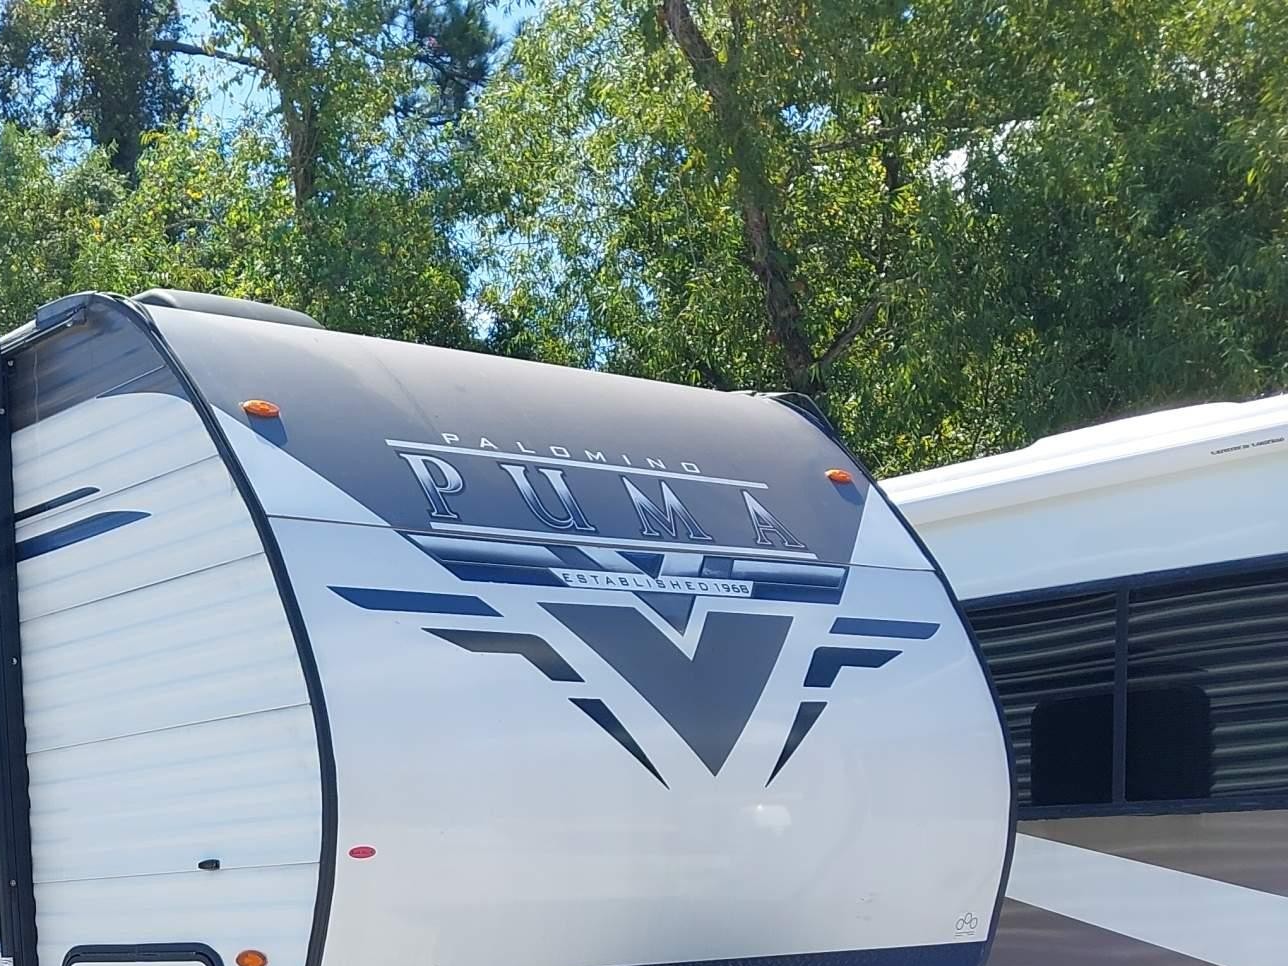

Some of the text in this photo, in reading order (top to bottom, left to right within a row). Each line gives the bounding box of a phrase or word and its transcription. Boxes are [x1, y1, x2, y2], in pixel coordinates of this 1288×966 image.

[441, 432, 701, 474] PALOMINO
[396, 452, 807, 549] PUMA
[562, 572, 750, 594] ESTABLISHED 1968
